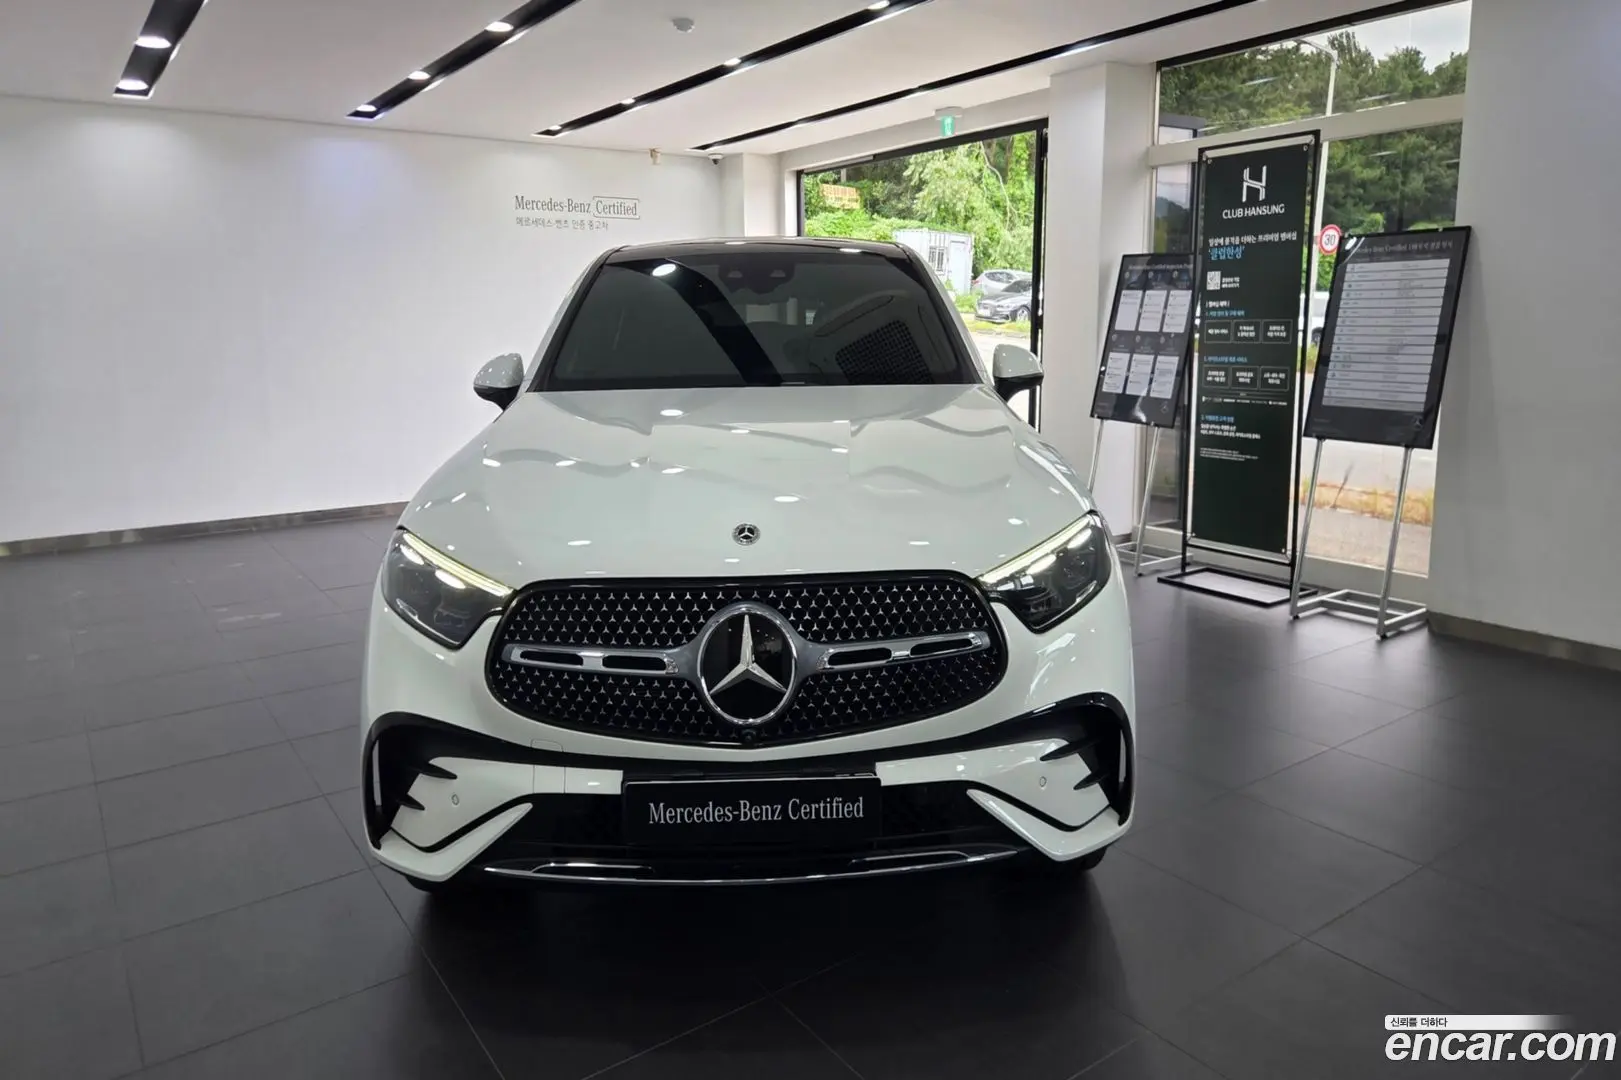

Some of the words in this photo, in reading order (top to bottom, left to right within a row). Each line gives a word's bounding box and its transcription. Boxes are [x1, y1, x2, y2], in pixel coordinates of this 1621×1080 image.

[514, 195, 591, 214] Mercedes-Benz
[595, 200, 637, 216] Certified
[1222, 207, 1243, 219] CLUB
[1244, 203, 1285, 217] HANSUNG
[572, 219, 585, 230] 인증
[587, 219, 608, 231] 중고차
[1324, 233, 1336, 246] 30
[648, 800, 782, 824] Mercedes-Benz
[788, 797, 864, 820] Certified
